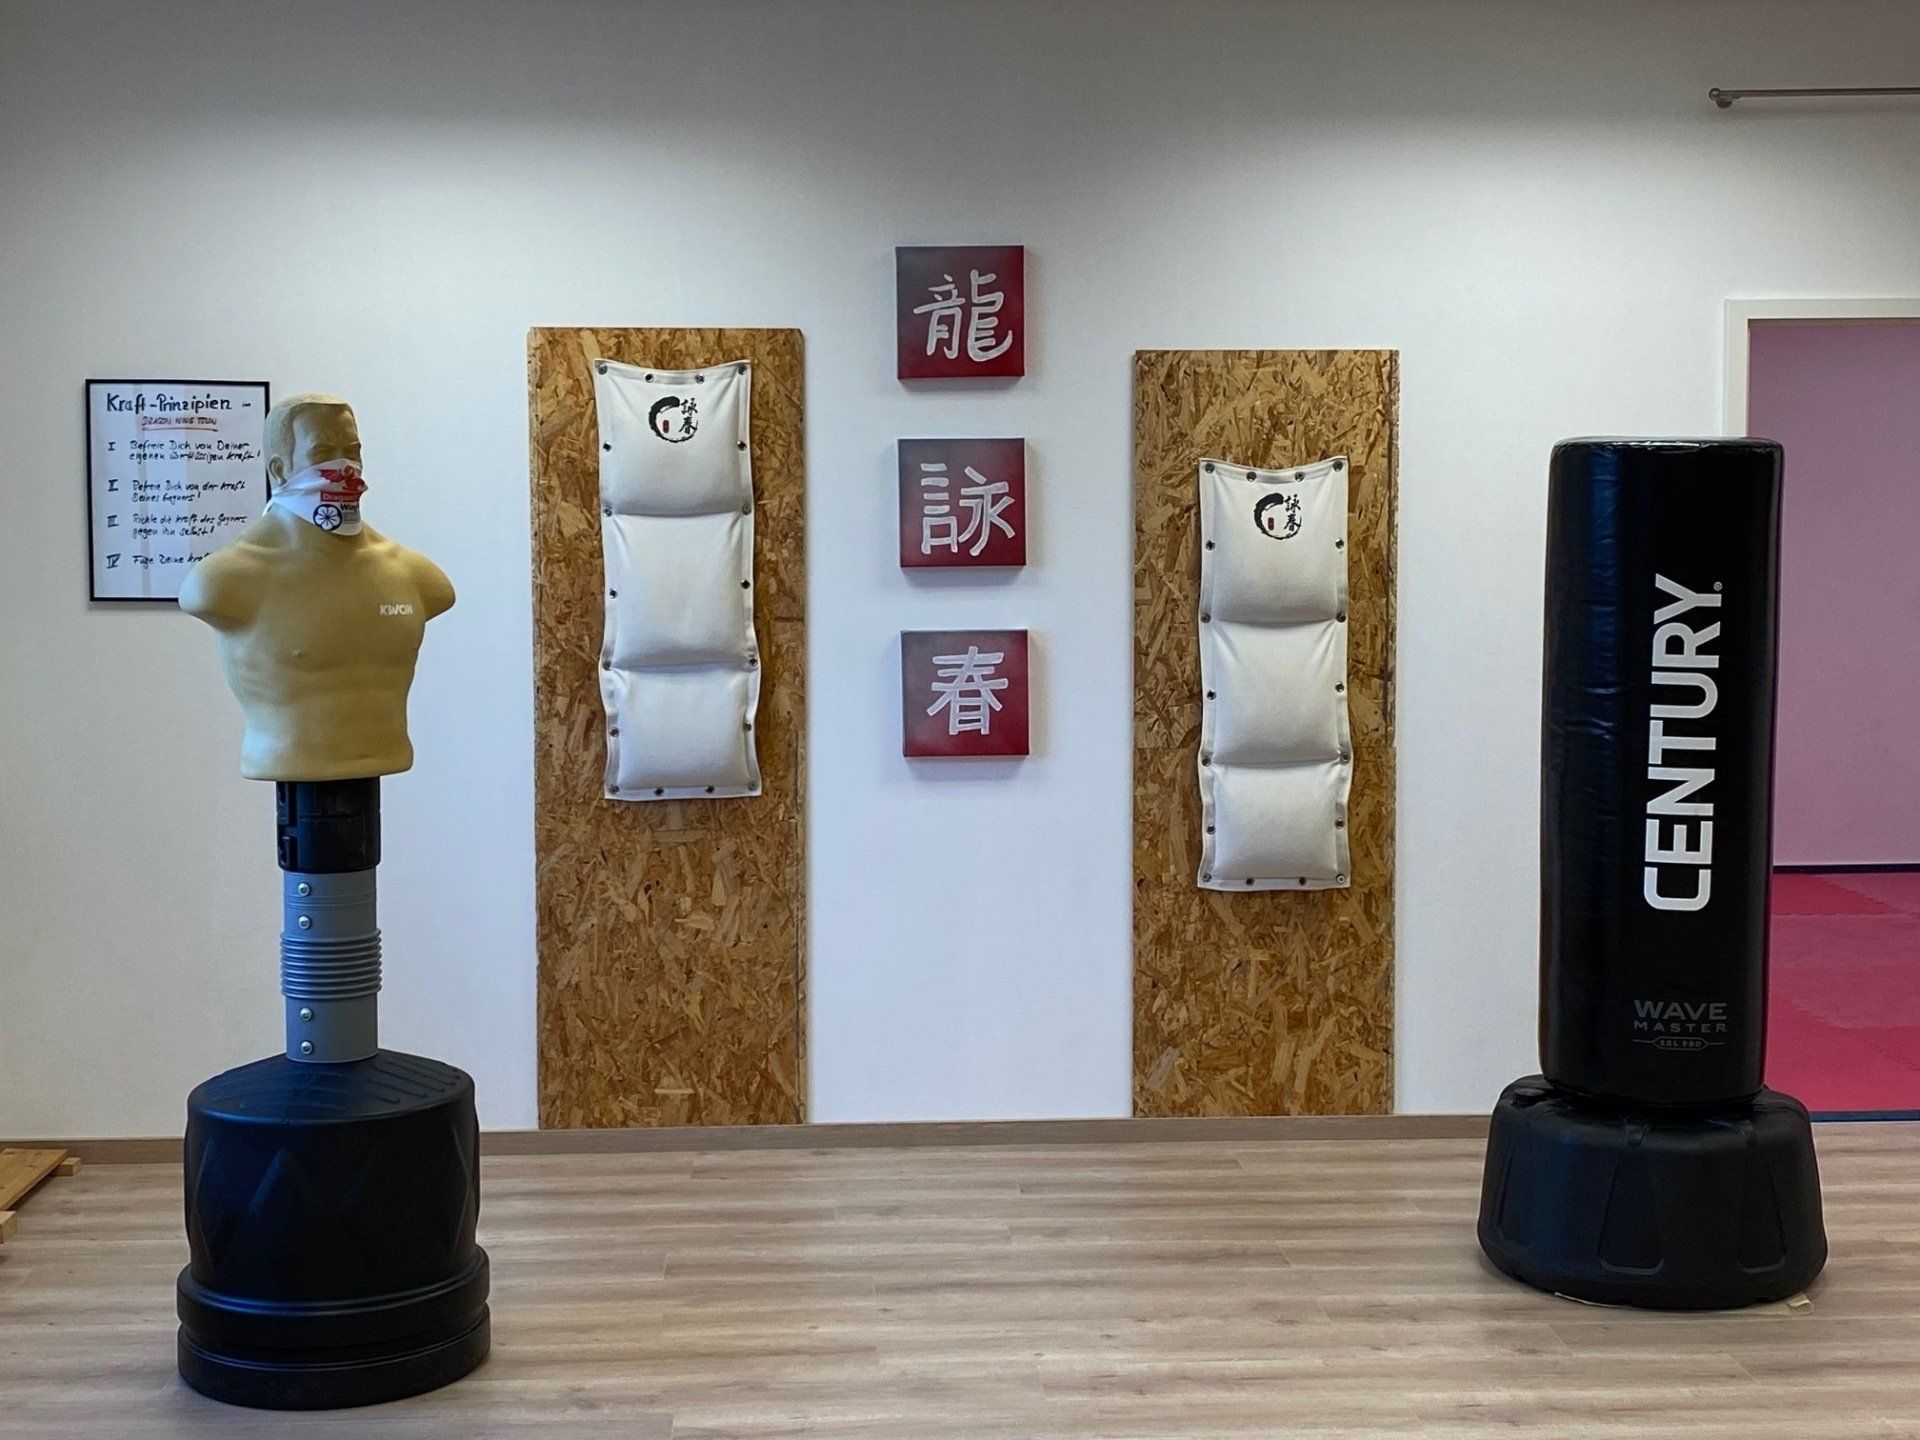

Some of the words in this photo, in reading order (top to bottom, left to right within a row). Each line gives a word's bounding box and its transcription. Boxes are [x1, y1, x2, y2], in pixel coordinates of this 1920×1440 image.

[913, 268, 1013, 362] 龍
[169, 440, 191, 450] Dich
[195, 443, 212, 451] von
[129, 451, 165, 464] eigenen
[166, 480, 182, 491] Dich
[202, 481, 219, 491] der
[921, 462, 1015, 556] 詠
[379, 604, 413, 616] KWON
[926, 645, 1009, 736] 春
[1633, 999, 1728, 1020] WAVE
[1633, 1020, 1726, 1033] MASTER
